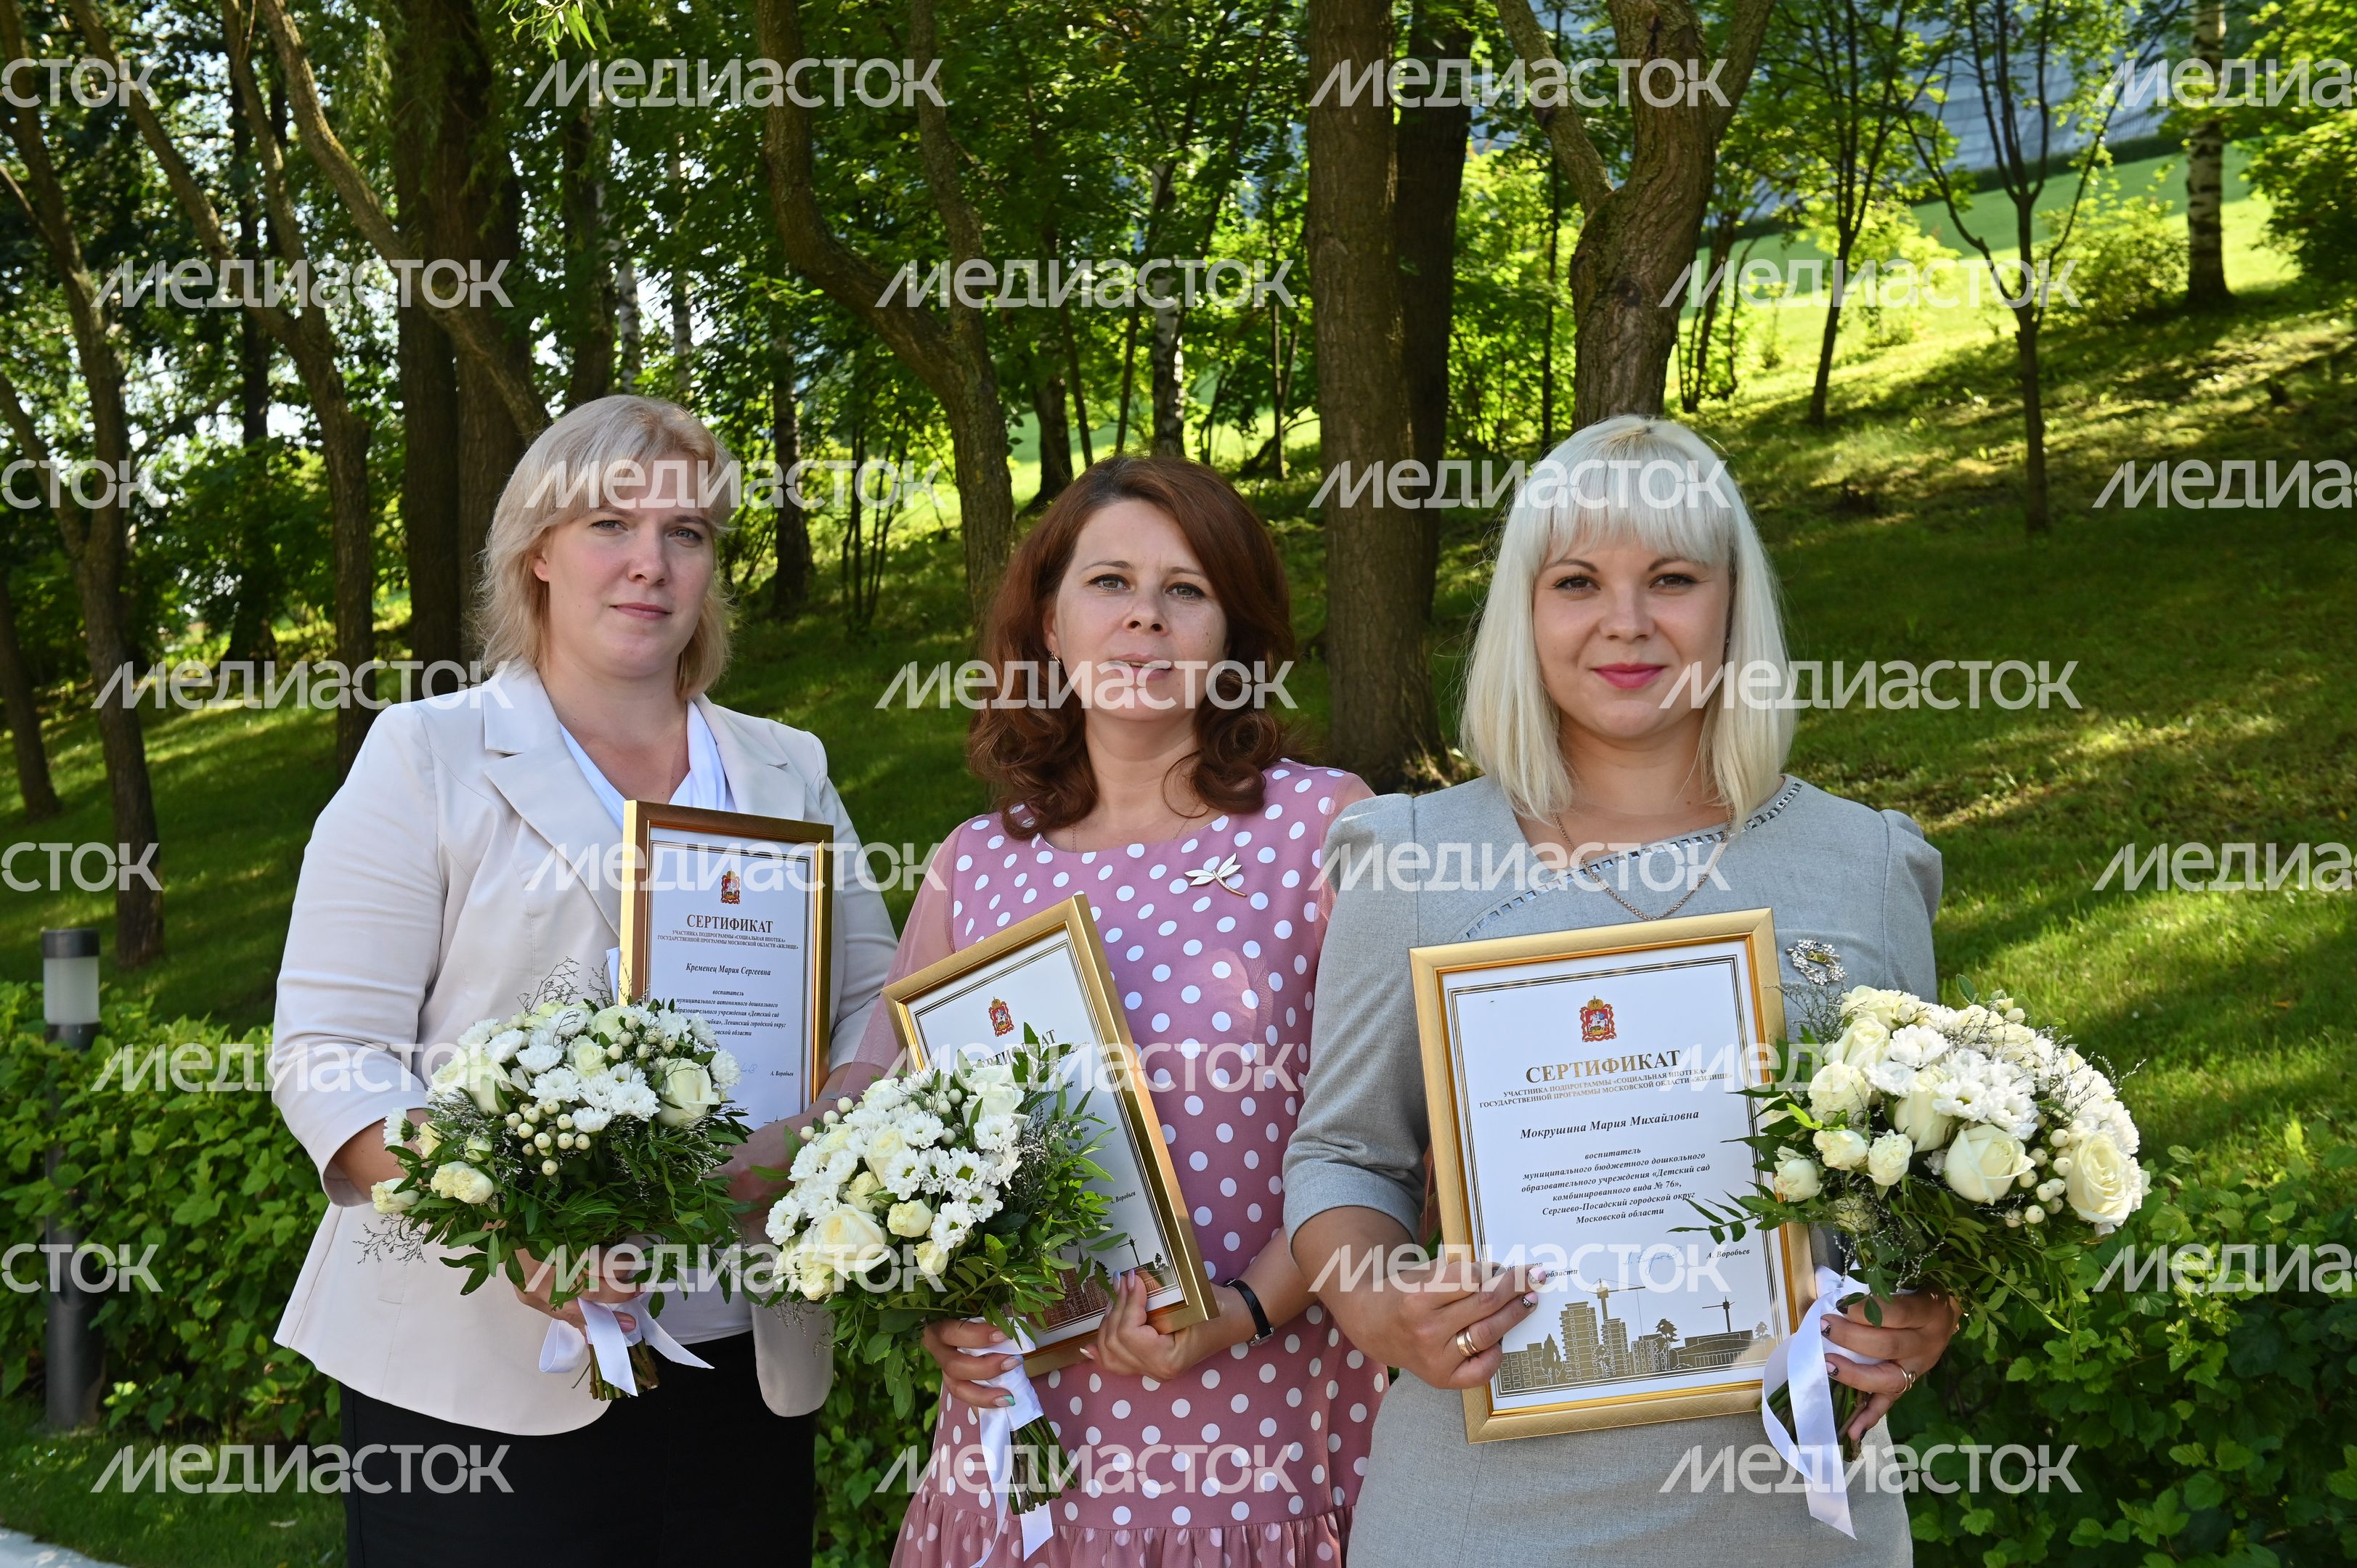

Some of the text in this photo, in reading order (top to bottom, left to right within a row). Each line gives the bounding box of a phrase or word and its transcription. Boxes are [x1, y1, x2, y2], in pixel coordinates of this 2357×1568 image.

[686, 914, 773, 934] СЕРТИФИКАТ
[685, 963, 771, 976] Кременец Мария Сергеевна
[1526, 1050, 1682, 1084] СЕРТИФИКАТ
[1479, 1094, 1552, 1108] ГОСУДАРСТВЕННОЙ
[1553, 1089, 1600, 1100] ПРОГРАММЫ
[1602, 1082, 1654, 1094] МОСКОВСКОЙ
[1655, 1077, 1690, 1089] ОБЛАСТИ
[1503, 1087, 1548, 1098] УЧАСТНИКА
[1550, 1079, 1612, 1093] ПОДПРОГРАММЫ
[1613, 1072, 1667, 1085] «СОЦИАЛЬНАЯ
[1520, 1110, 1700, 1140] Мокрушина Мария Михайловна
[1522, 1152, 1706, 1180] муниципального бюджетного дошкольного
[1584, 1147, 1641, 1160] воспитатель
[1521, 1164, 1711, 1193] образовательного учреждения «Детский сад
[1552, 1180, 1682, 1202] комбинированного вида № 76»,
[1542, 1191, 1696, 1216] Сергиево-Посадский городской округ
[1576, 1207, 1665, 1225] Московской области
[1706, 1247, 1751, 1259] А. Воробьев
